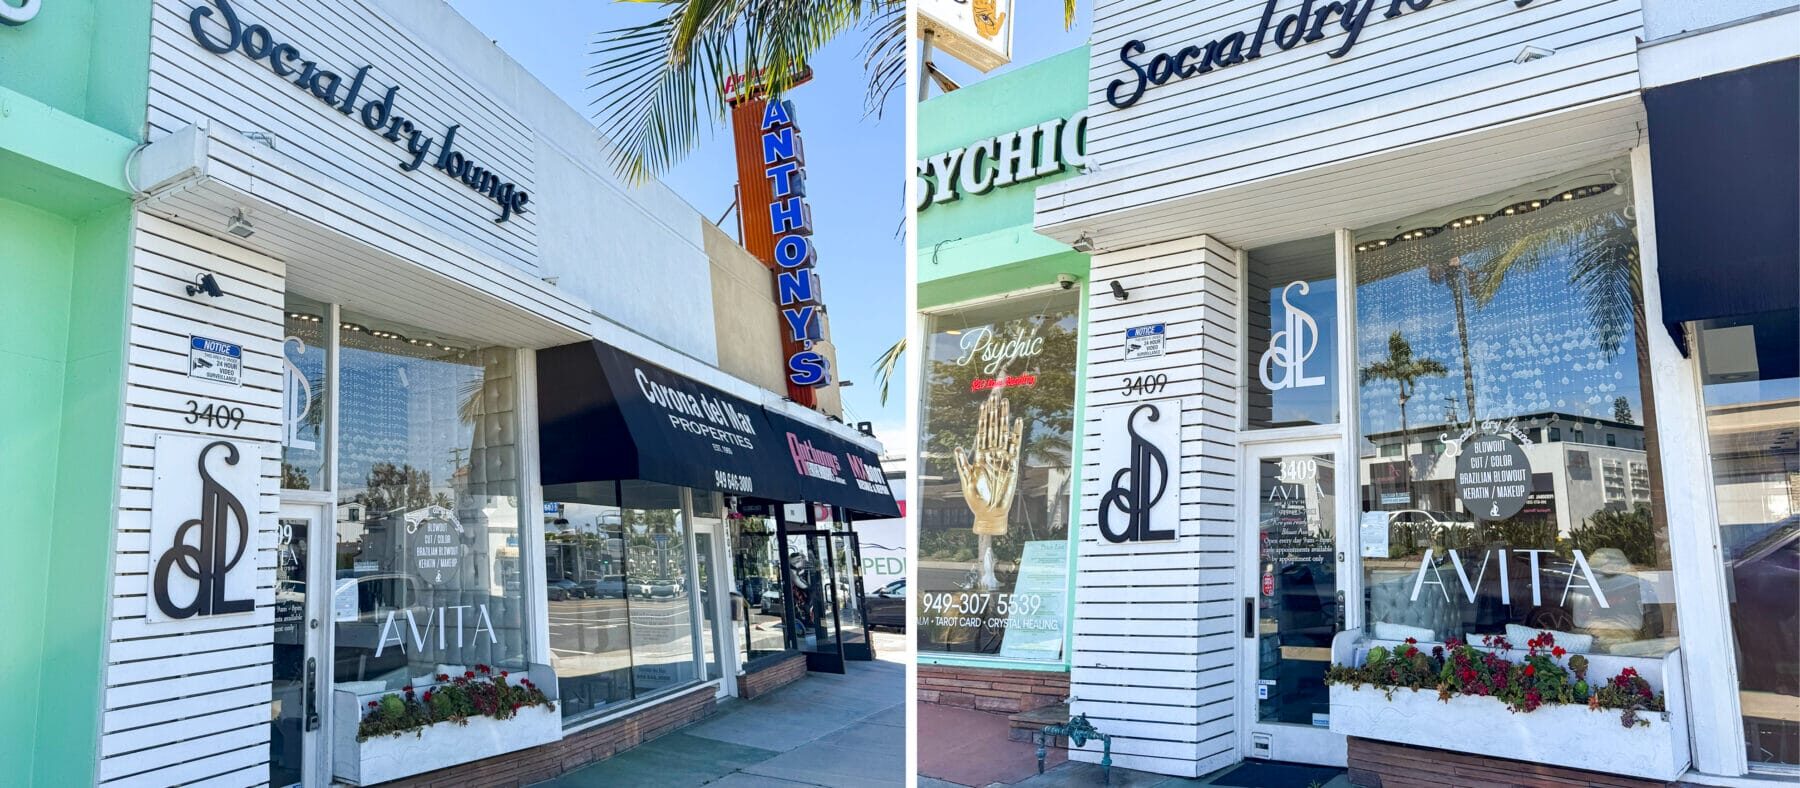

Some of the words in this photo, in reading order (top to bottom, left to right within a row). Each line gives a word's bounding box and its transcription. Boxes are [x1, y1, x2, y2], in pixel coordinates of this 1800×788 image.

[1106, 0, 1276, 109] Social
[189, 0, 373, 115] Social
[361, 85, 433, 172] dry
[434, 124, 529, 223] lounge
[761, 98, 823, 384] ANTHONY'S
[1135, 326, 1154, 336] NOTICE
[204, 340, 231, 354] NOTICE
[957, 326, 1042, 375] Psychic
[219, 368, 234, 376] VIDEO
[1121, 374, 1168, 397] 3409
[634, 367, 704, 419] Corona
[700, 393, 730, 428] del
[721, 400, 757, 436] Mar
[184, 400, 245, 431] 3409
[1480, 413, 1503, 435] dry
[668, 413, 754, 450] PROPERTIES
[1474, 440, 1506, 454] BLOWOUT
[1275, 460, 1317, 481] 3409
[1470, 456, 1483, 469] CUT
[1490, 454, 1513, 468] COLOR
[714, 469, 728, 489] 949
[727, 472, 754, 493] 646-3000
[1459, 471, 1492, 485] BRAZILIAN
[1493, 469, 1526, 483] BLOWOUT
[1463, 486, 1490, 500] KERATIN
[1496, 485, 1525, 499] MAKEUP
[1263, 537, 1278, 545] Open
[1279, 538, 1292, 546] every
[1293, 536, 1302, 545] day
[1276, 547, 1310, 555] appointments
[1311, 545, 1333, 553] available
[1279, 555, 1311, 564] appointment
[1312, 554, 1325, 564] only
[1410, 549, 1610, 608] AVITA
[923, 592, 990, 614] 949-307
[997, 592, 1042, 616] 5539
[375, 604, 497, 657] AVITA
[935, 616, 958, 627] TAROT
[959, 617, 982, 628] CARD
[988, 617, 1021, 629] CRYSTAL
